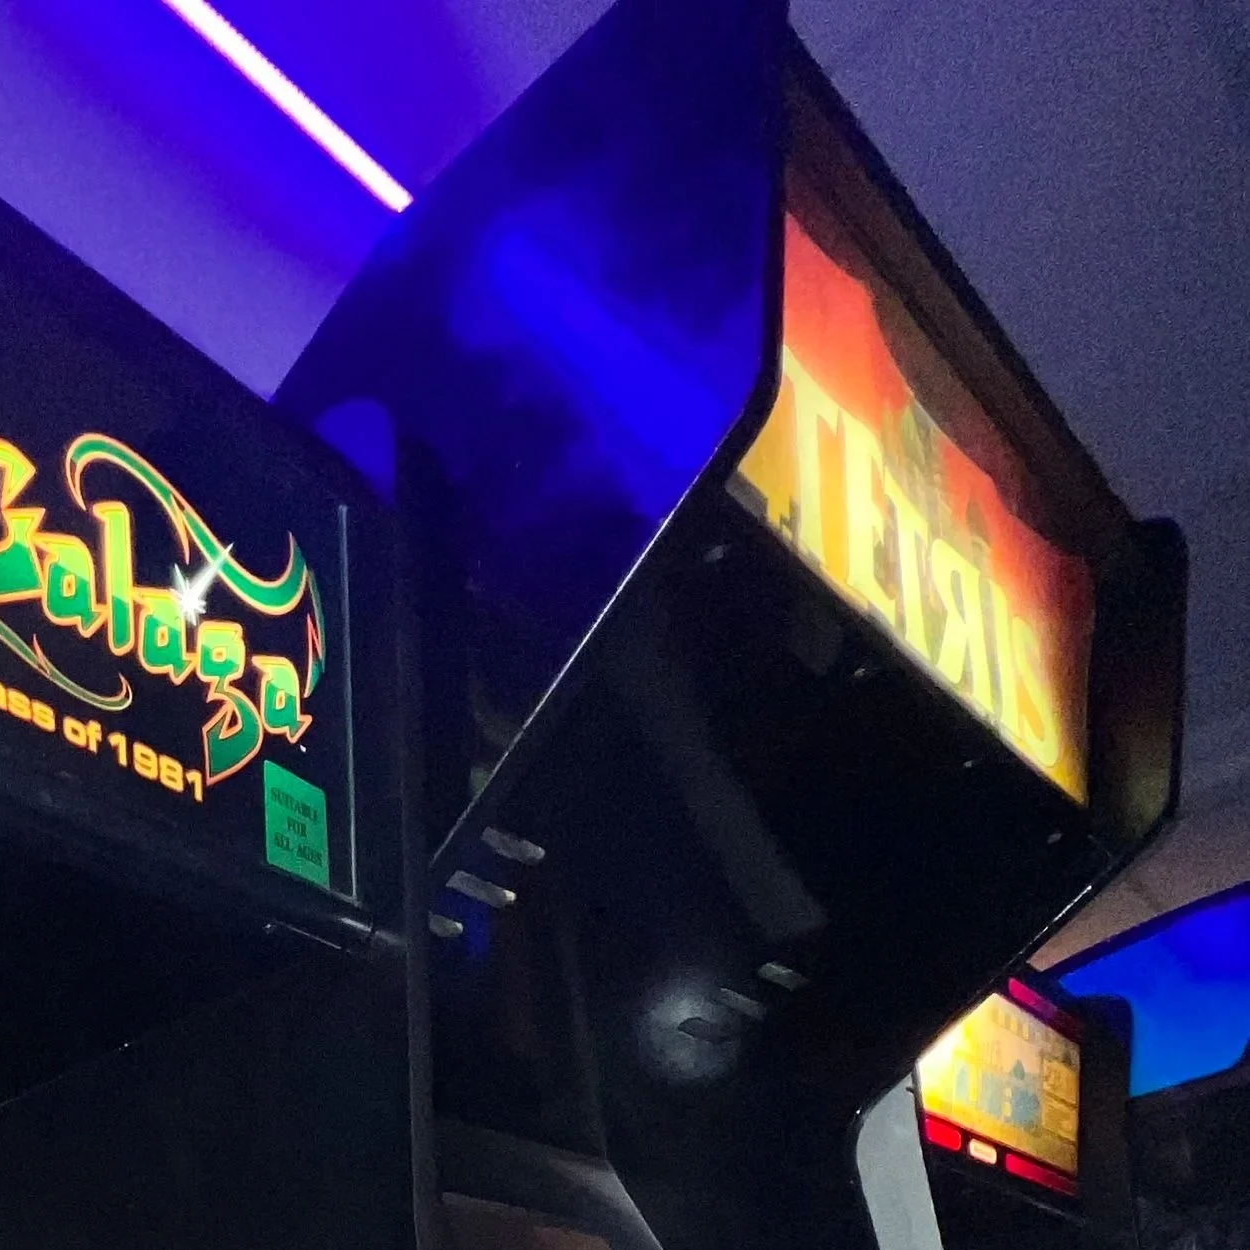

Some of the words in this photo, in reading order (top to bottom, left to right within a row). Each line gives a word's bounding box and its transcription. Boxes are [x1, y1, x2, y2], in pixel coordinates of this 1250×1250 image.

[61, 714, 103, 754] of
[106, 731, 204, 803] 1981
[286, 815, 308, 839] FOR
